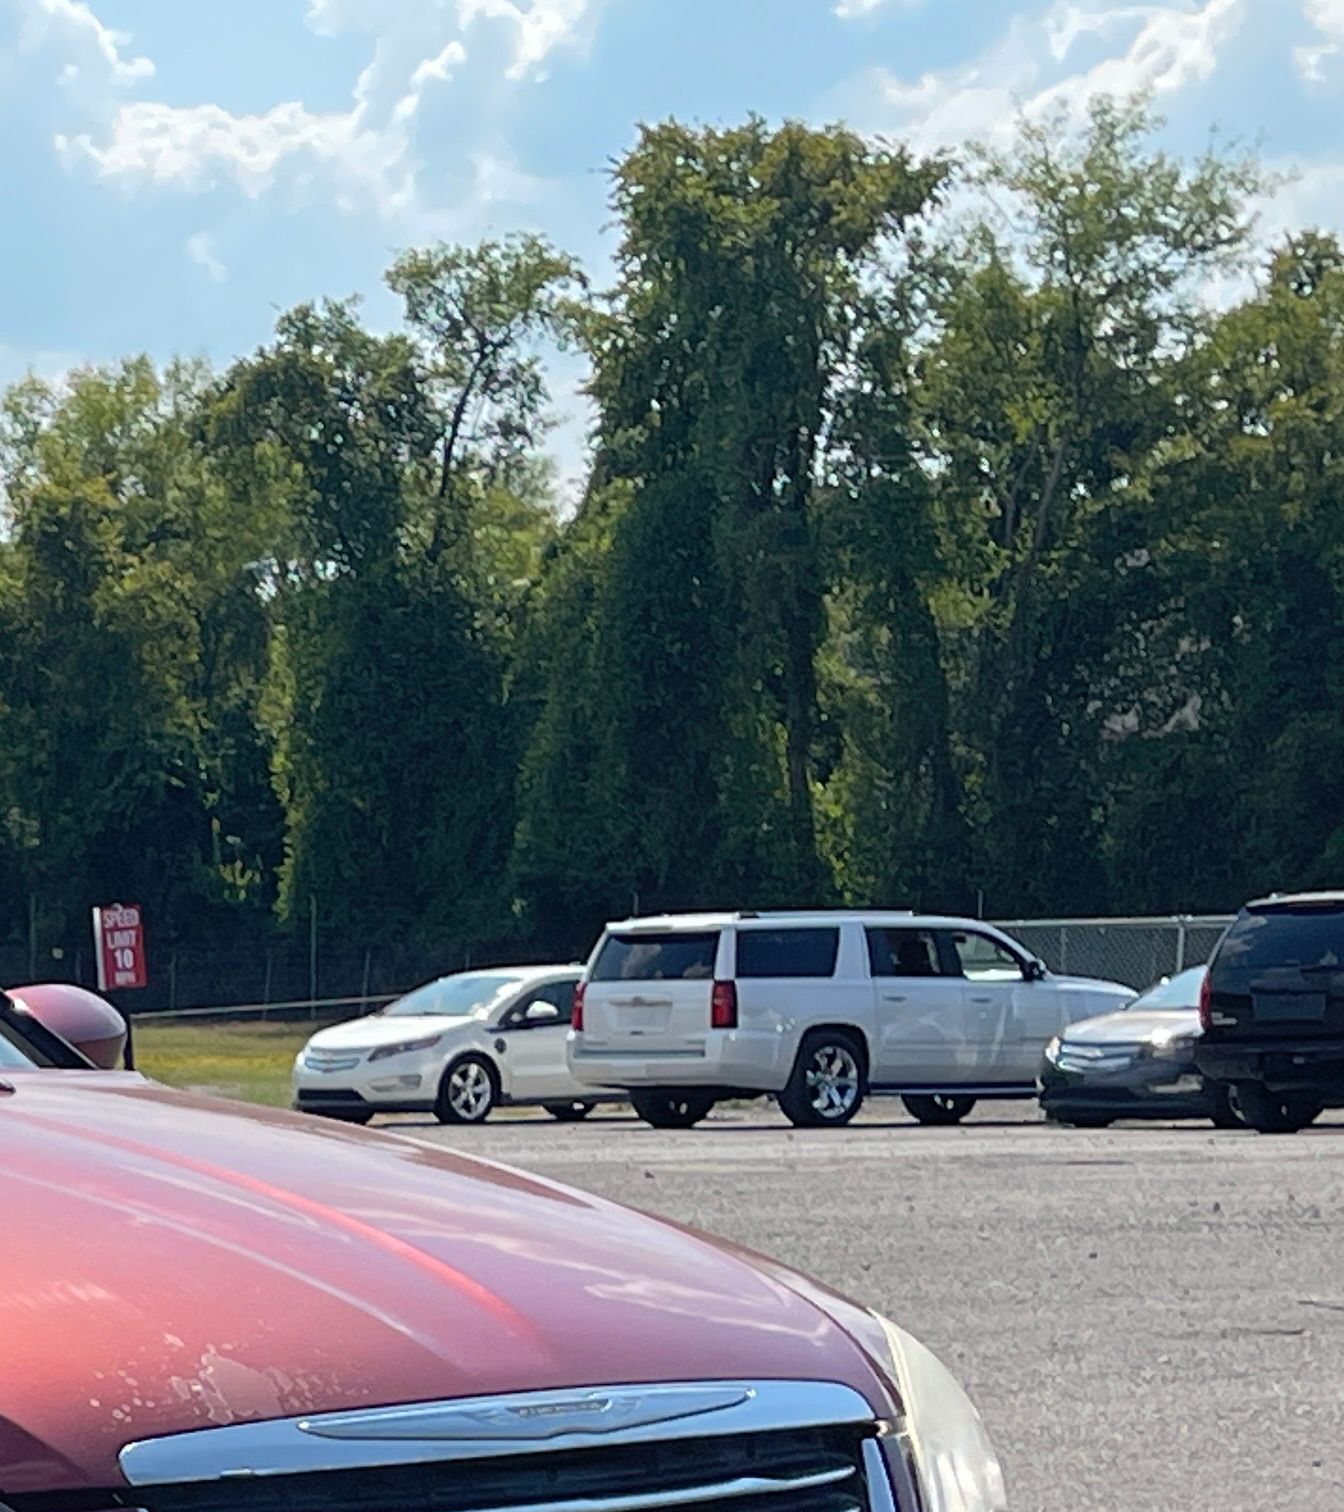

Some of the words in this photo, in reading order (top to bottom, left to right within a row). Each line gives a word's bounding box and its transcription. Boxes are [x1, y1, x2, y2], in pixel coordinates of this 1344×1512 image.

[104, 908, 139, 928] SPEED
[107, 929, 135, 949] LIMIT
[114, 949, 134, 969] 10
